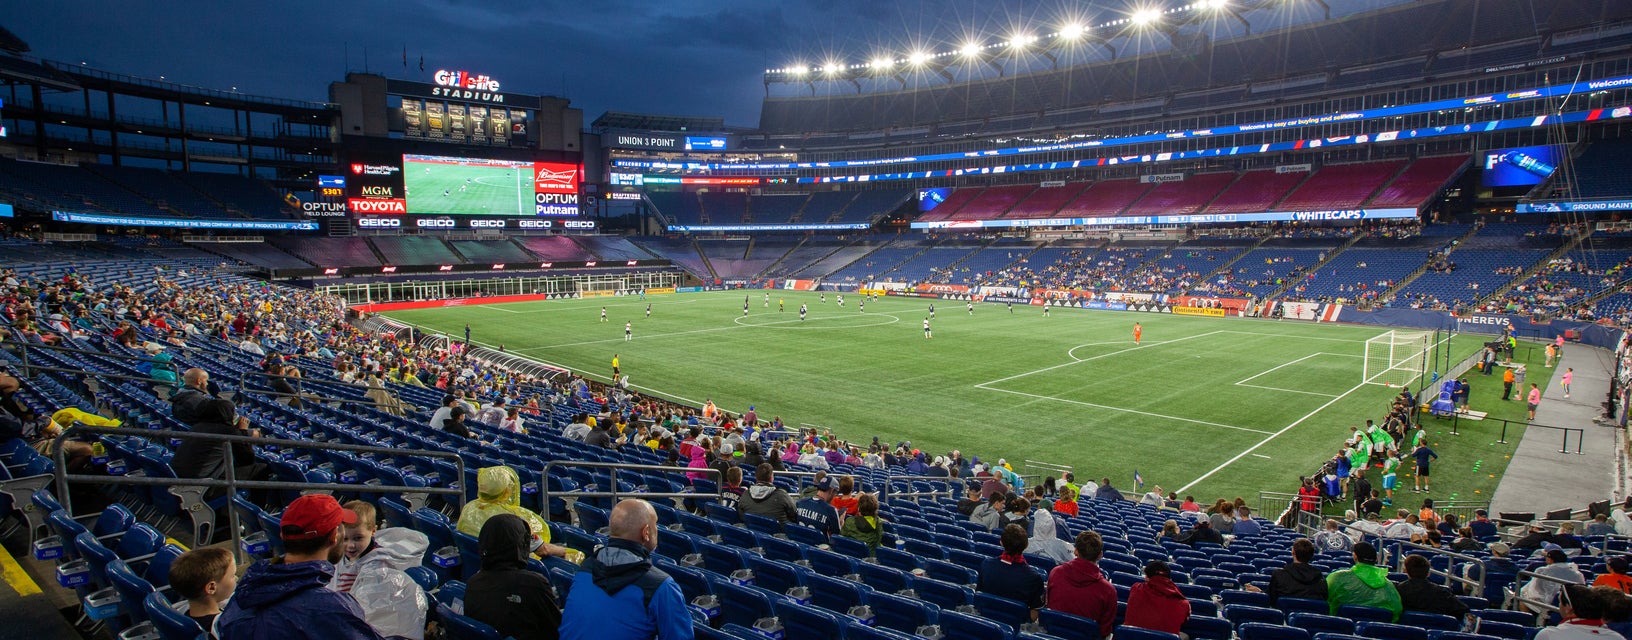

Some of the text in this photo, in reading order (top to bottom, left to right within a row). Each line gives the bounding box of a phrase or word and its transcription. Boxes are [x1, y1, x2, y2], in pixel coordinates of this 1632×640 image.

[434, 70, 500, 92] Gillette
[432, 87, 504, 102] STADIUM
[618, 136, 642, 145] UNION
[651, 138, 675, 147] POINT
[362, 186, 392, 195] MGM
[536, 194, 578, 204] OPTUM
[303, 202, 345, 211] OPTUM
[352, 201, 404, 211] TOYOTA
[536, 205, 578, 214] Putnam
[1296, 210, 1361, 220] WHITECAPS
[417, 219, 455, 228] GEICO
[796, 508, 827, 523] WELLMN
